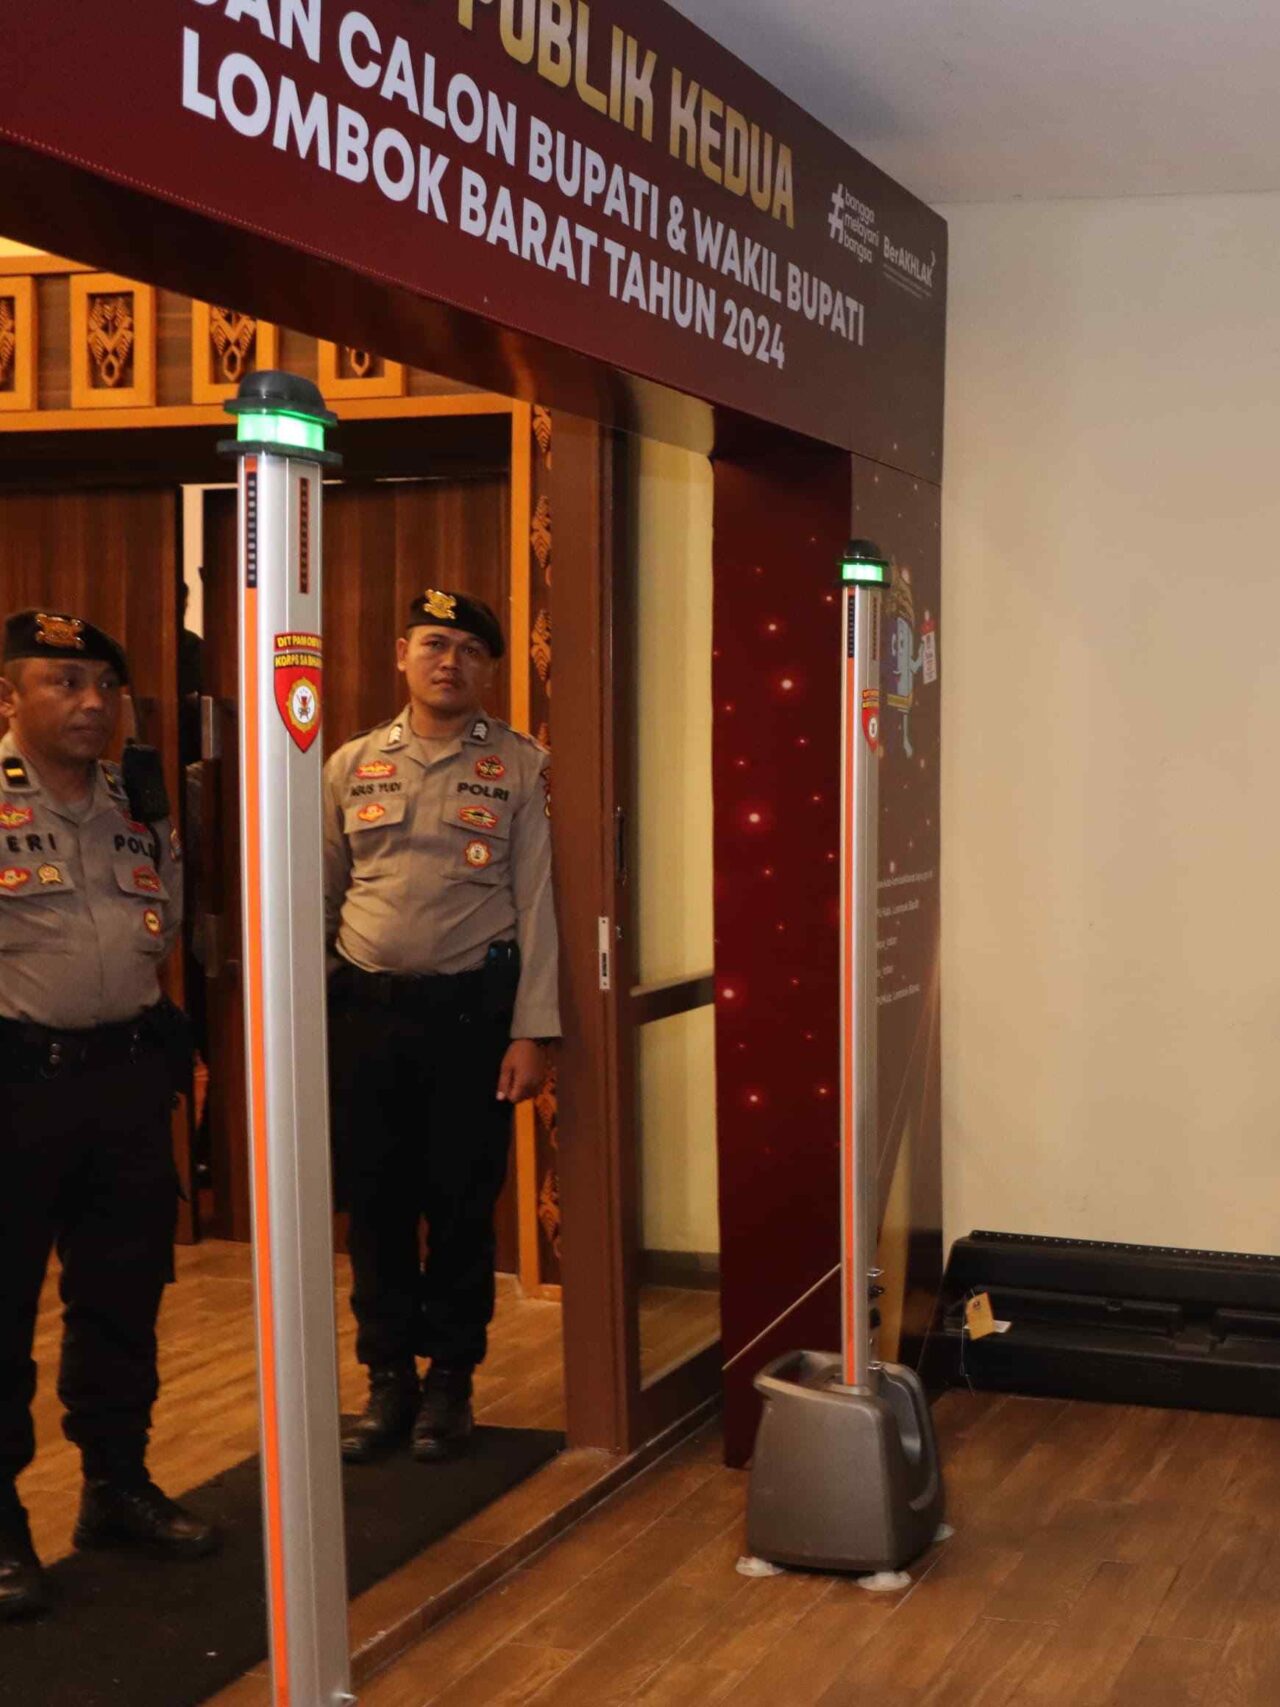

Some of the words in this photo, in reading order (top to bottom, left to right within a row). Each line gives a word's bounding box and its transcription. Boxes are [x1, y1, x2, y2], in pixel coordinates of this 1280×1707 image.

[182, 26, 449, 223] LOMBOK
[460, 166, 599, 287] BARAT
[603, 237, 716, 339] TAHUN
[723, 299, 785, 369] 2024
[338, 11, 516, 166] CALON
[528, 116, 658, 240] BUPATI
[666, 195, 687, 254] &
[693, 208, 781, 303] WAKIL
[787, 263, 864, 346] BUPATI
[458, 0, 656, 142] UBLIK
[669, 67, 795, 229] KEDUA
[6, 833, 57, 852] ERI
[457, 782, 510, 802] POLRI
